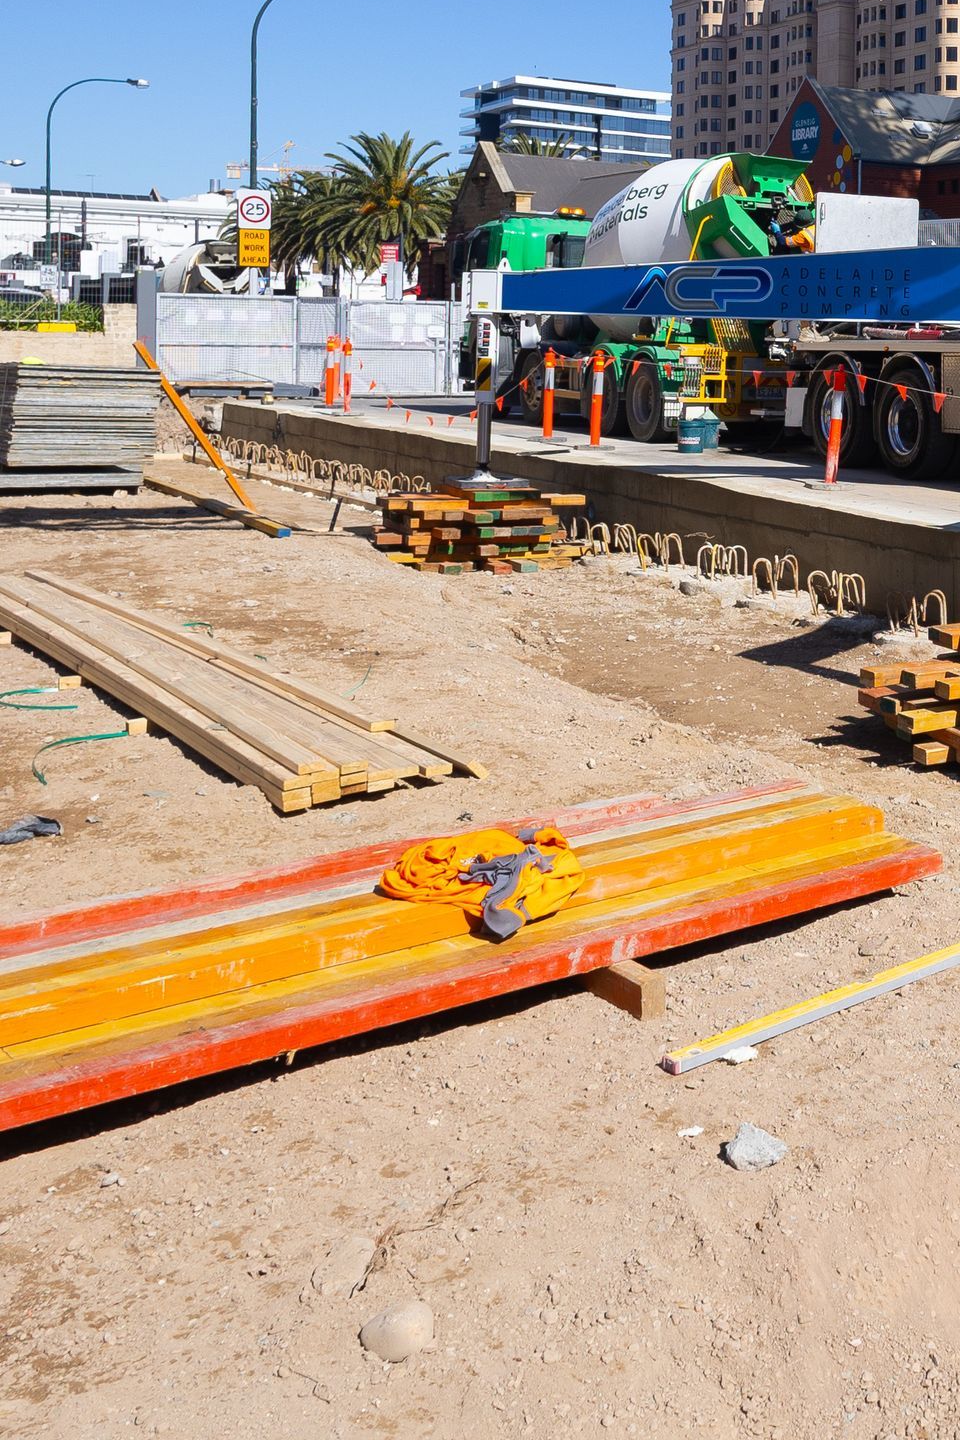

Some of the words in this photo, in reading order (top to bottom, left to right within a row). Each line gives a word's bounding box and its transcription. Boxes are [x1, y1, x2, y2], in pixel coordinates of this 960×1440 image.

[791, 125, 819, 142] LIBRARY
[245, 202, 265, 216] 25
[244, 232, 265, 240] ROAD
[244, 244, 265, 252] WORK
[242, 256, 267, 264] AHEAD
[780, 267, 911, 282] ADELAIDE
[622, 266, 774, 312] ACP
[780, 285, 911, 299] CONCRETE
[780, 302, 911, 317] PUMPING
